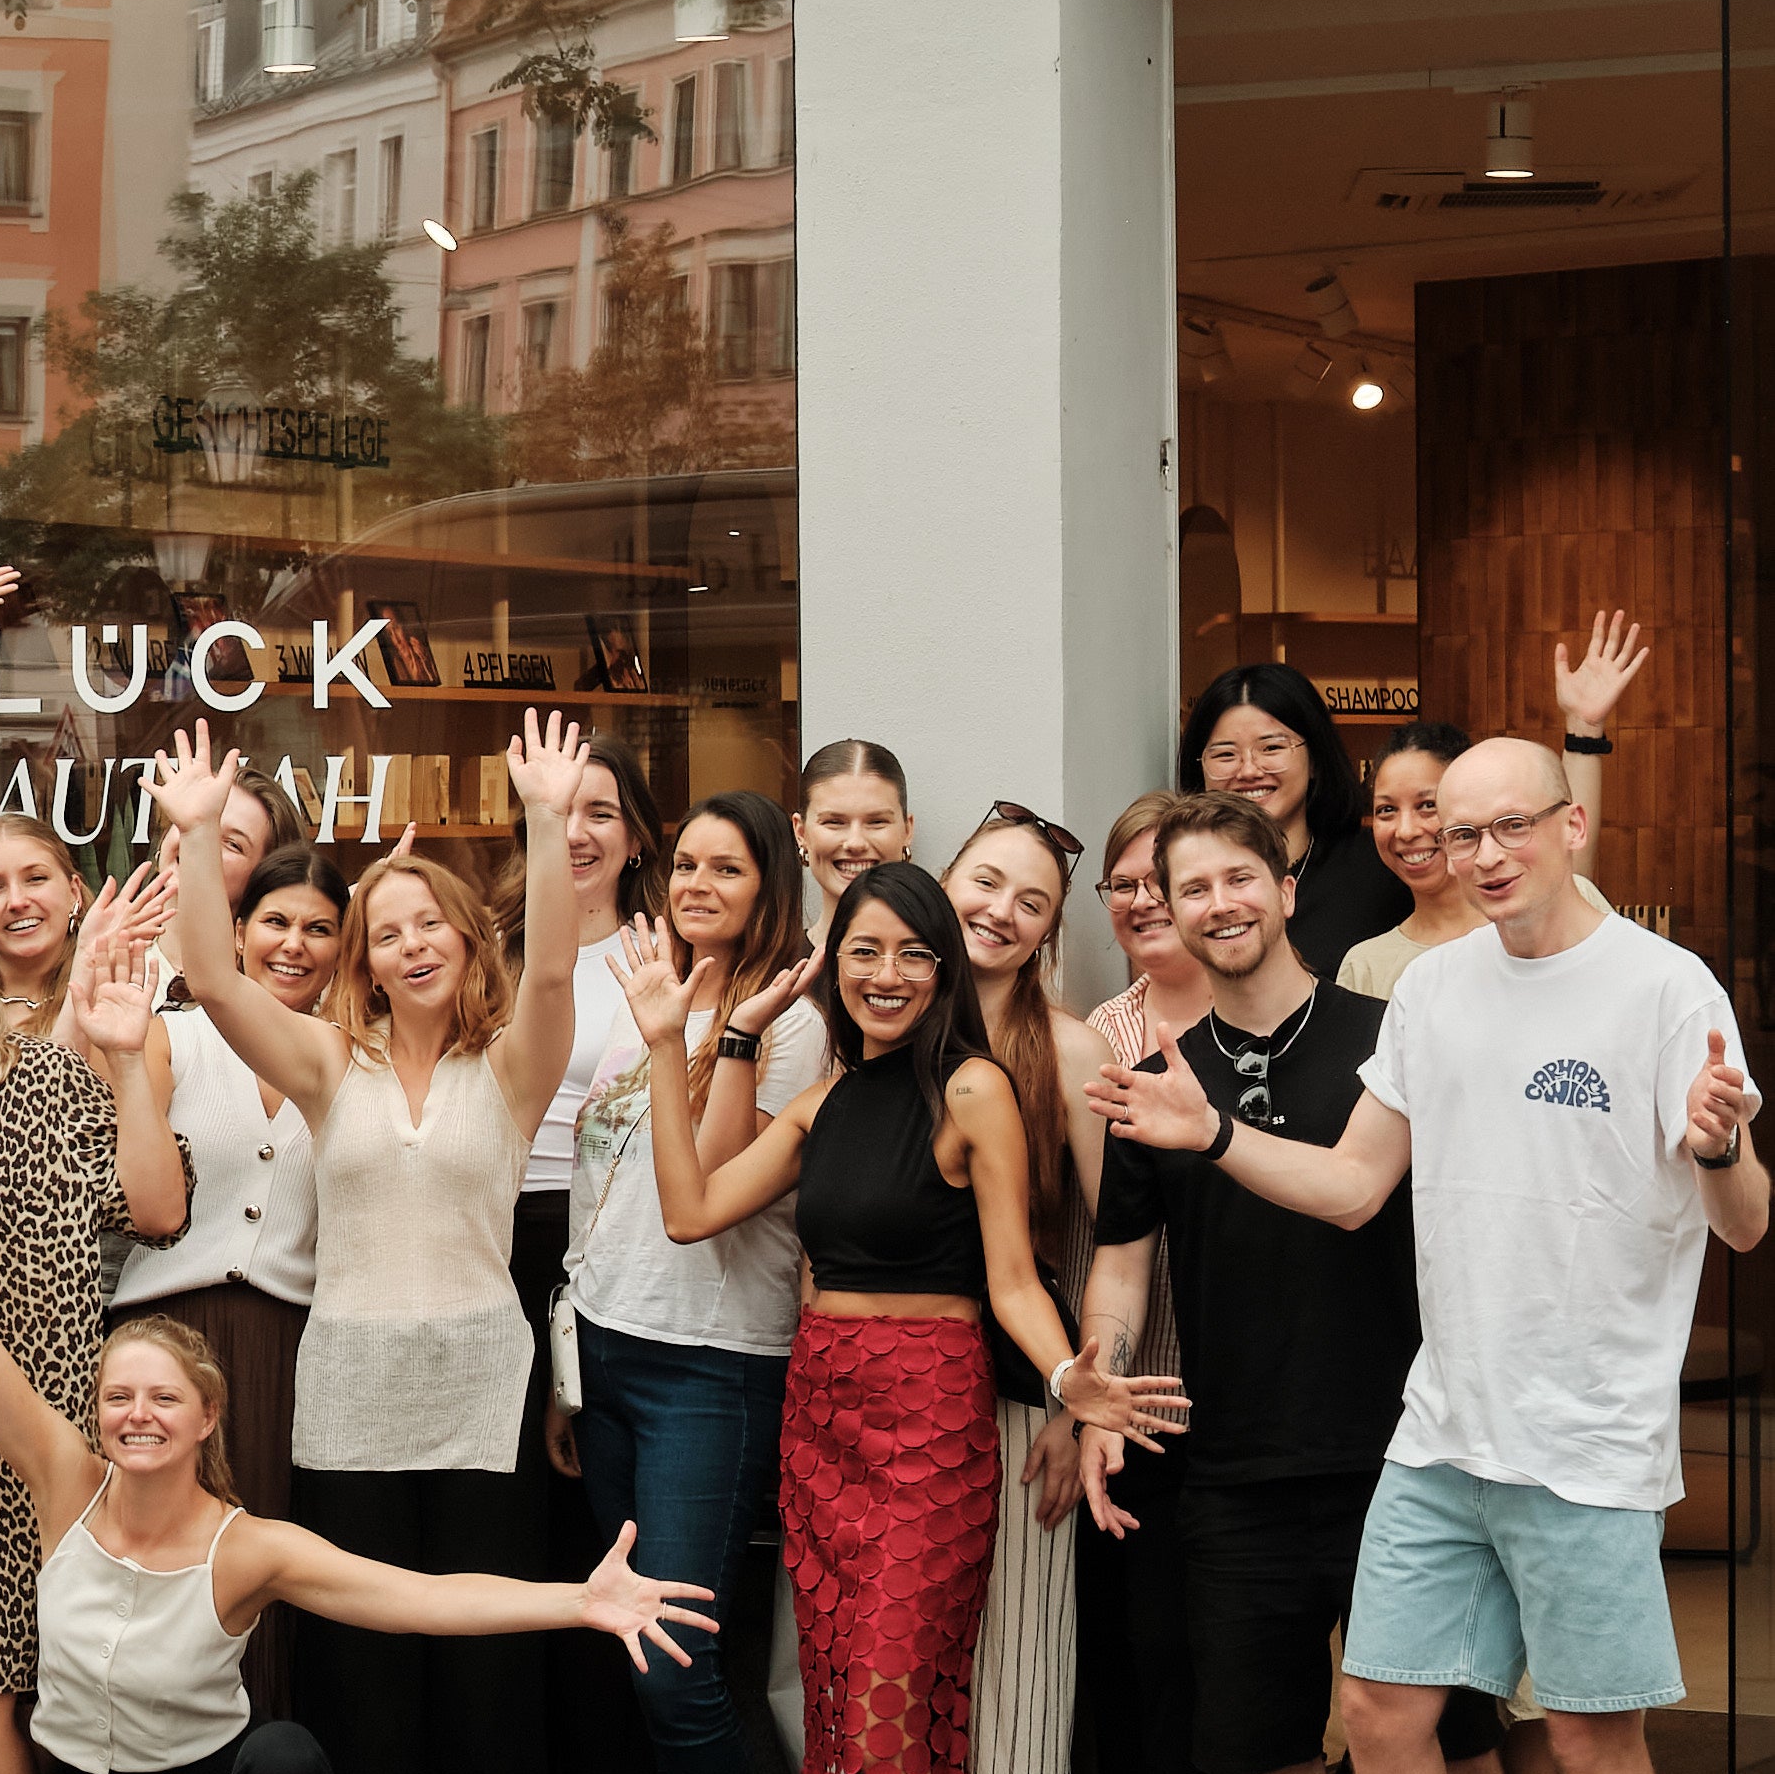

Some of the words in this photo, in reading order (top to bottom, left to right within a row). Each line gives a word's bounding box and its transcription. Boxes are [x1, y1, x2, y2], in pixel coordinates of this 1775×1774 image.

[153, 396, 390, 465] GESICHTSPFLEGE
[463, 652, 474, 680] 4
[477, 652, 554, 684] PFLEGEN
